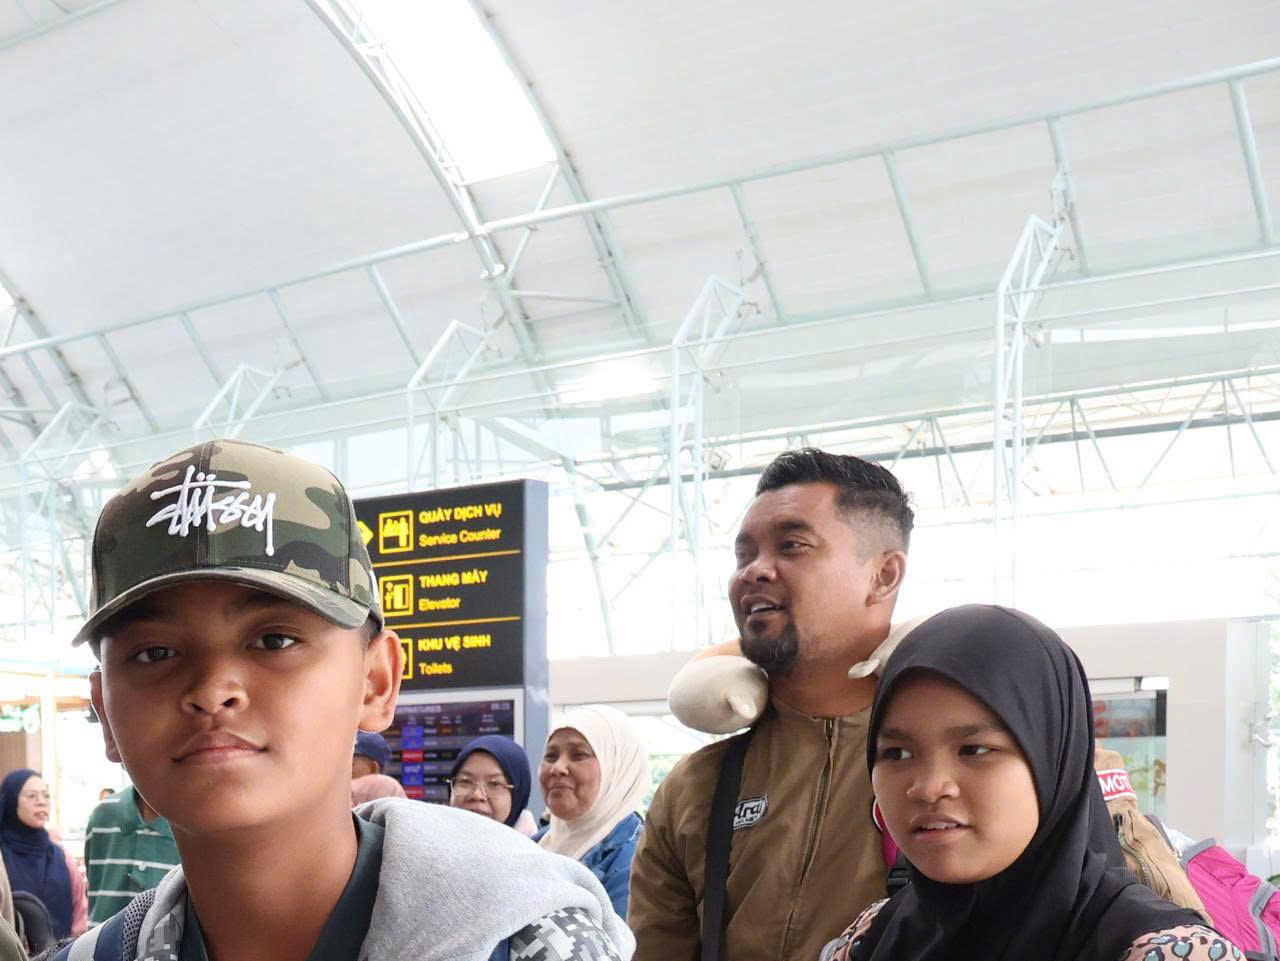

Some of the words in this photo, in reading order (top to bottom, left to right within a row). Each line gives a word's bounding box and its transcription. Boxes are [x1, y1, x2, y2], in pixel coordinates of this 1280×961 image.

[419, 532, 458, 547] Service
[459, 528, 502, 543] Counter
[419, 572, 460, 588] THANG
[418, 597, 461, 611] Elevator
[418, 637, 443, 651] KHU
[462, 634, 491, 648] SINH
[418, 662, 453, 675] Toilets
